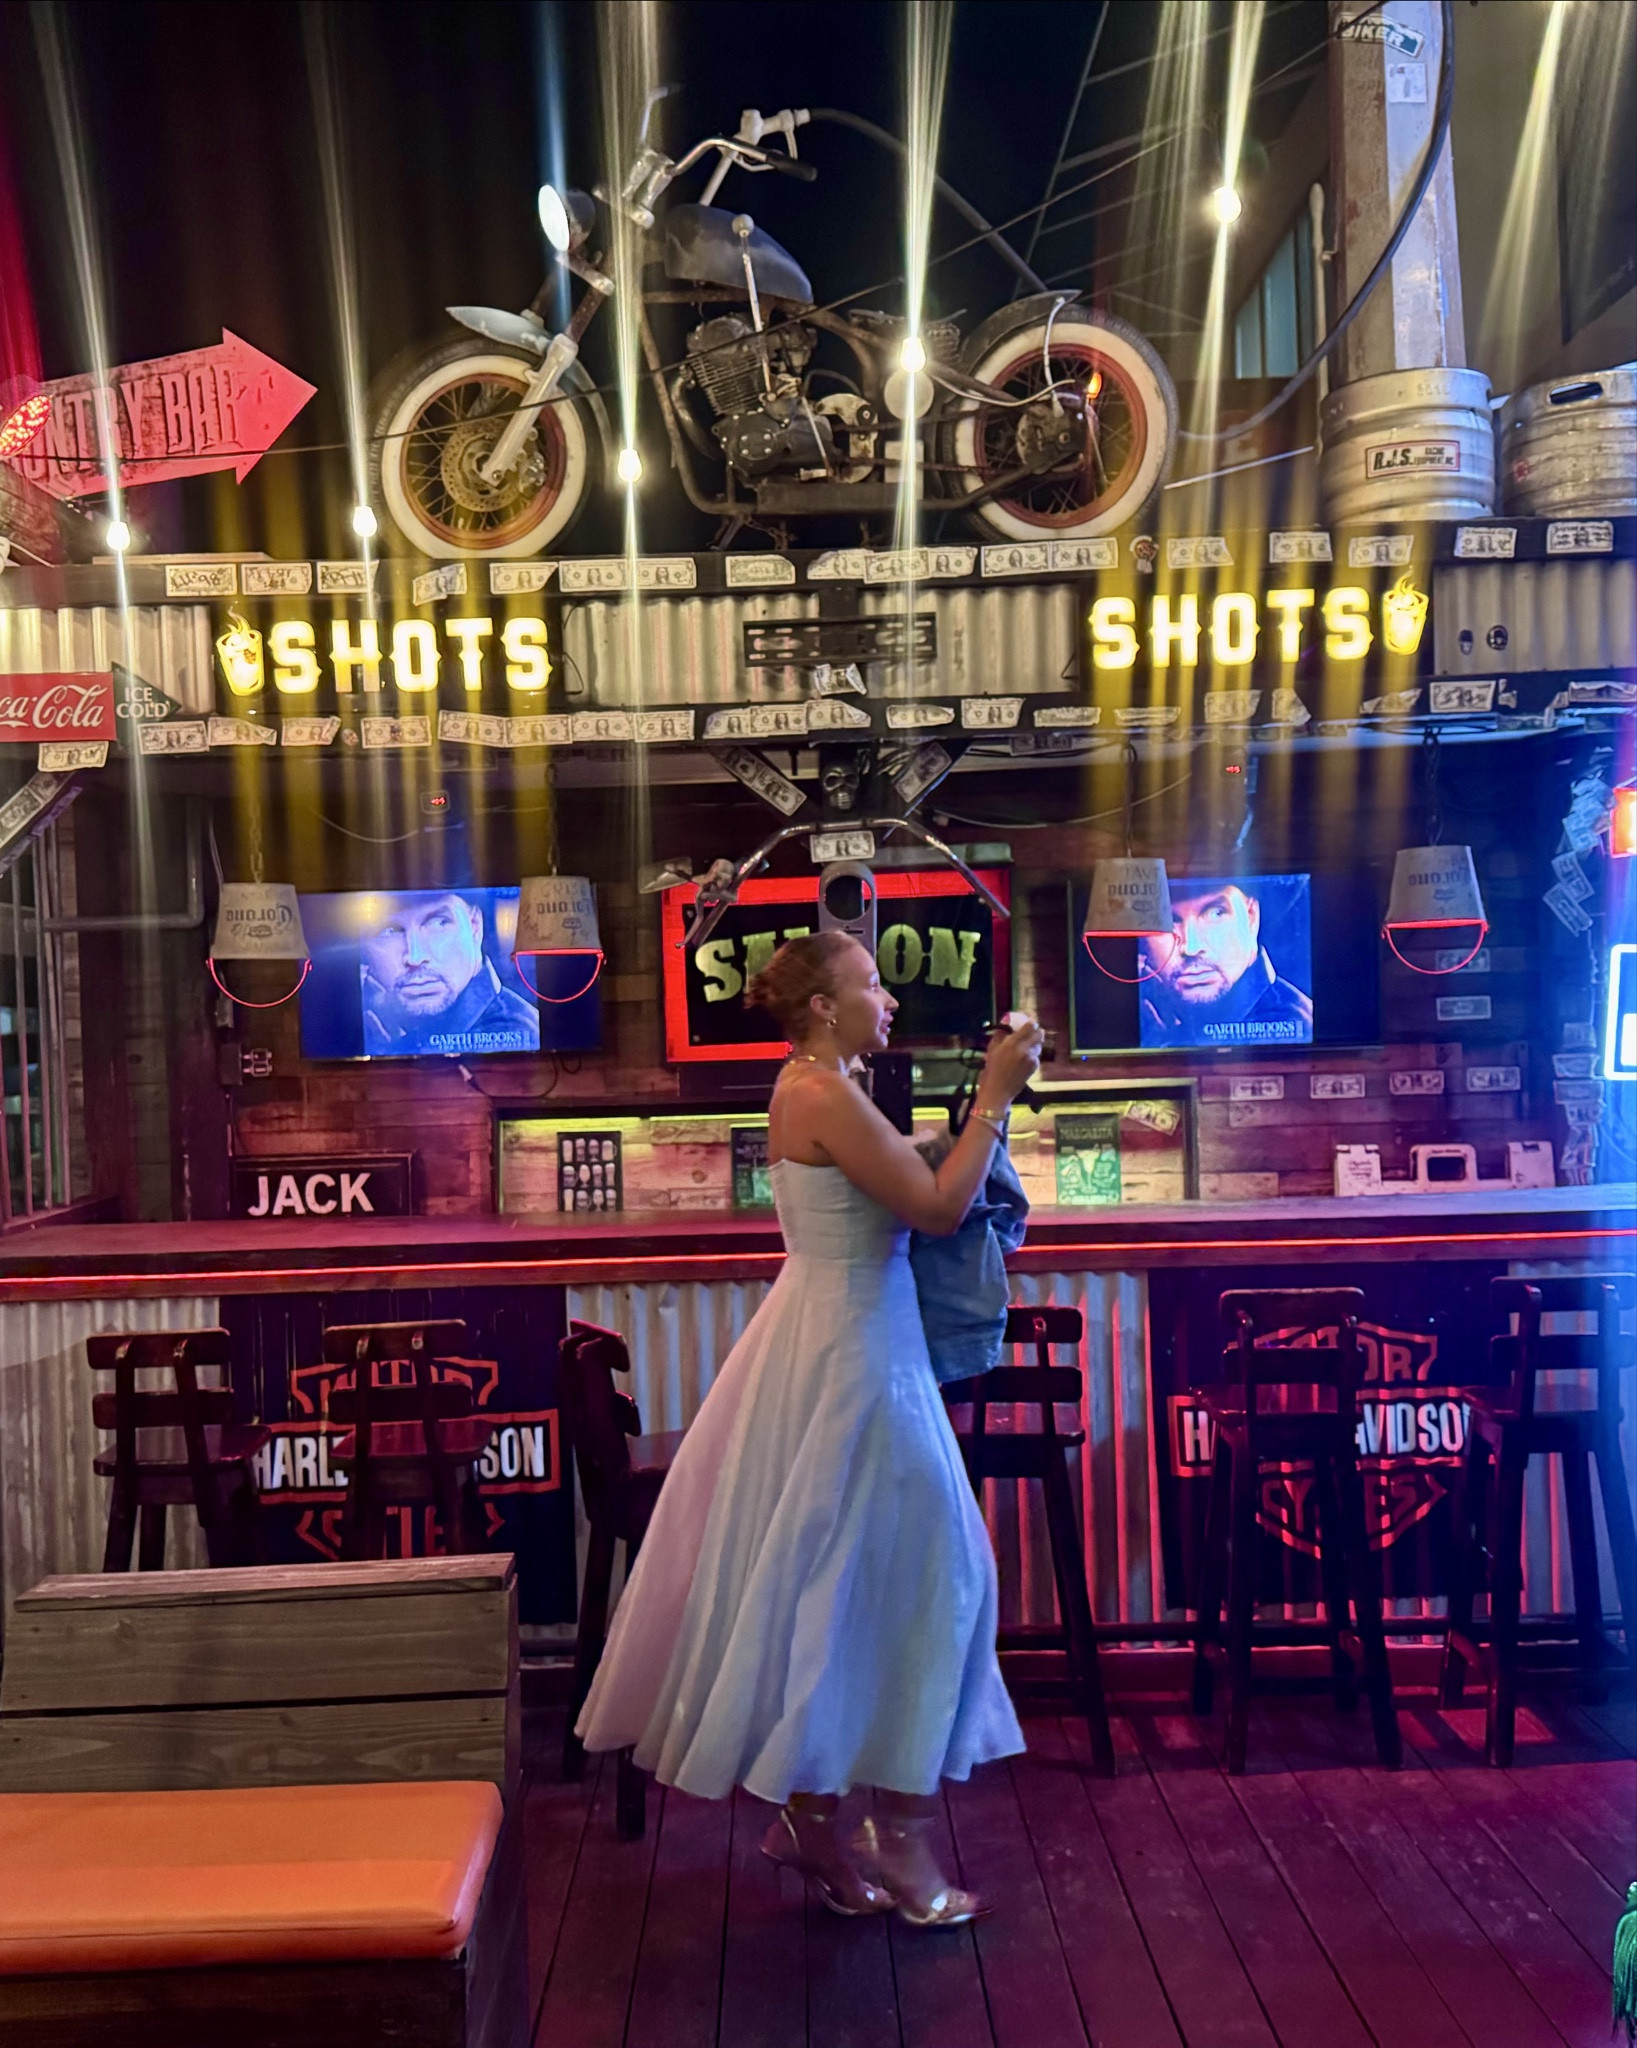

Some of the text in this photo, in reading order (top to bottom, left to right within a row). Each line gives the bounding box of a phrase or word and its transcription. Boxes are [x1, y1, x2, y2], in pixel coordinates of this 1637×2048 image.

[160, 364, 244, 455] BAR
[1088, 586, 1374, 670] SHOTS
[267, 617, 553, 694] SHOTS
[125, 687, 153, 702] ICE
[226, 903, 293, 926] Corona
[429, 1033, 472, 1046] GARTH
[473, 1031, 521, 1043] BROOKS
[1203, 1022, 1245, 1035] GARTH
[1246, 1020, 1295, 1033] BROOKS
[247, 1172, 375, 1216] JACK
